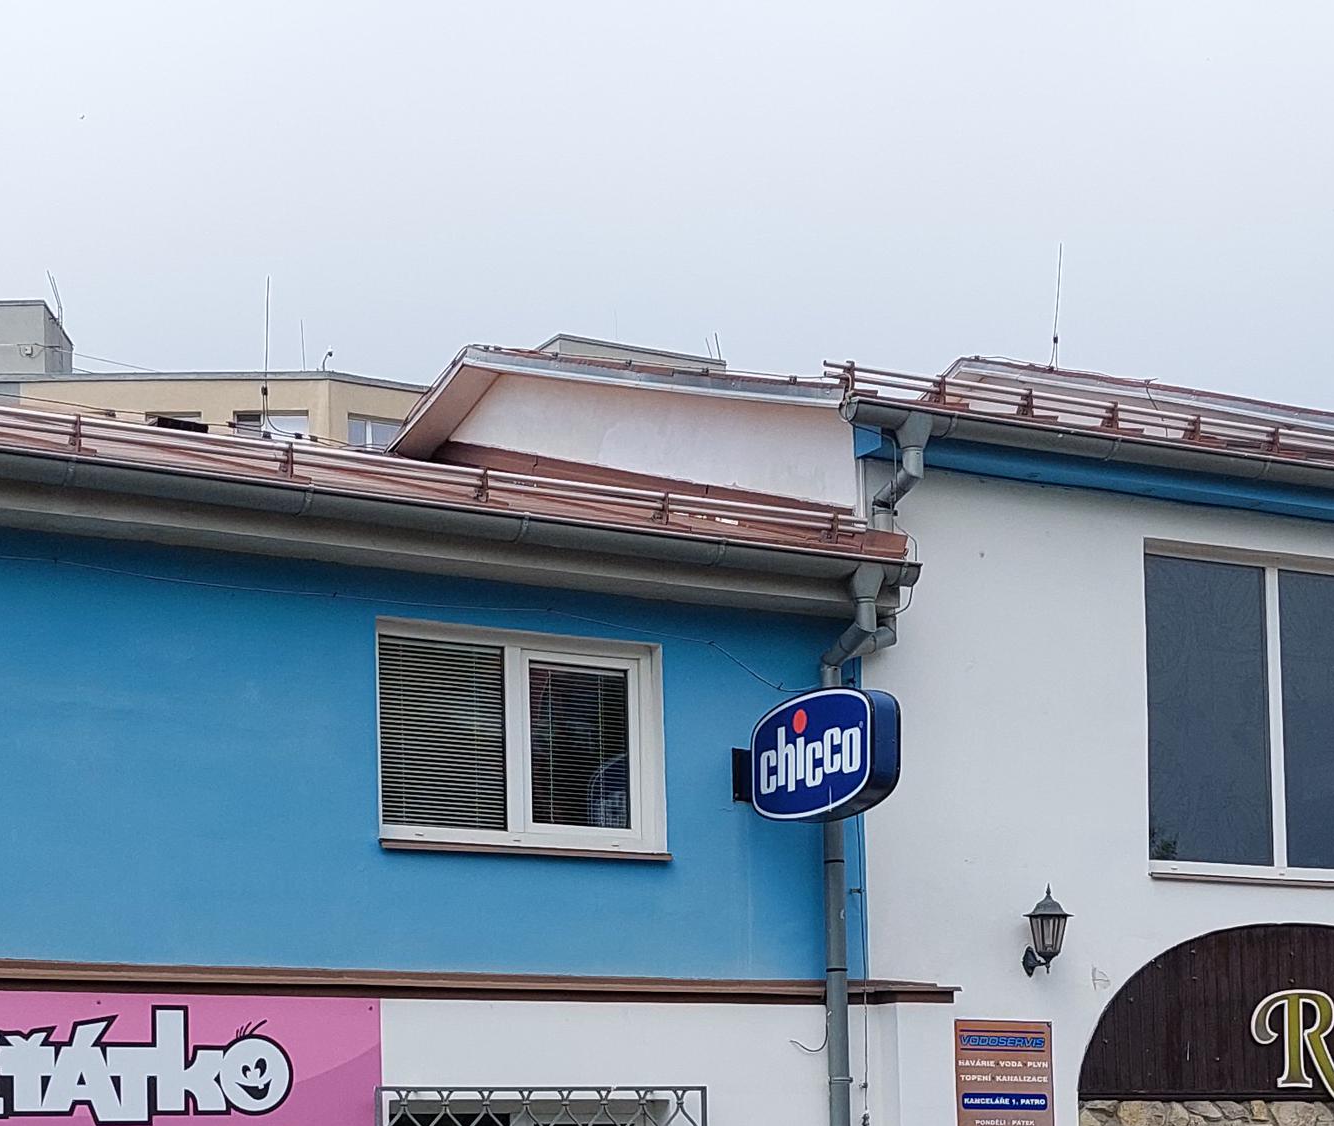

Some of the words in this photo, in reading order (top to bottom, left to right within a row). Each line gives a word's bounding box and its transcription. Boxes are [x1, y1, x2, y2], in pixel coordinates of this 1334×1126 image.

[760, 709, 861, 794] chicco
[960, 1035, 1045, 1048] VODOSERVIS
[996, 1075, 1048, 1083] KANALIZACE
